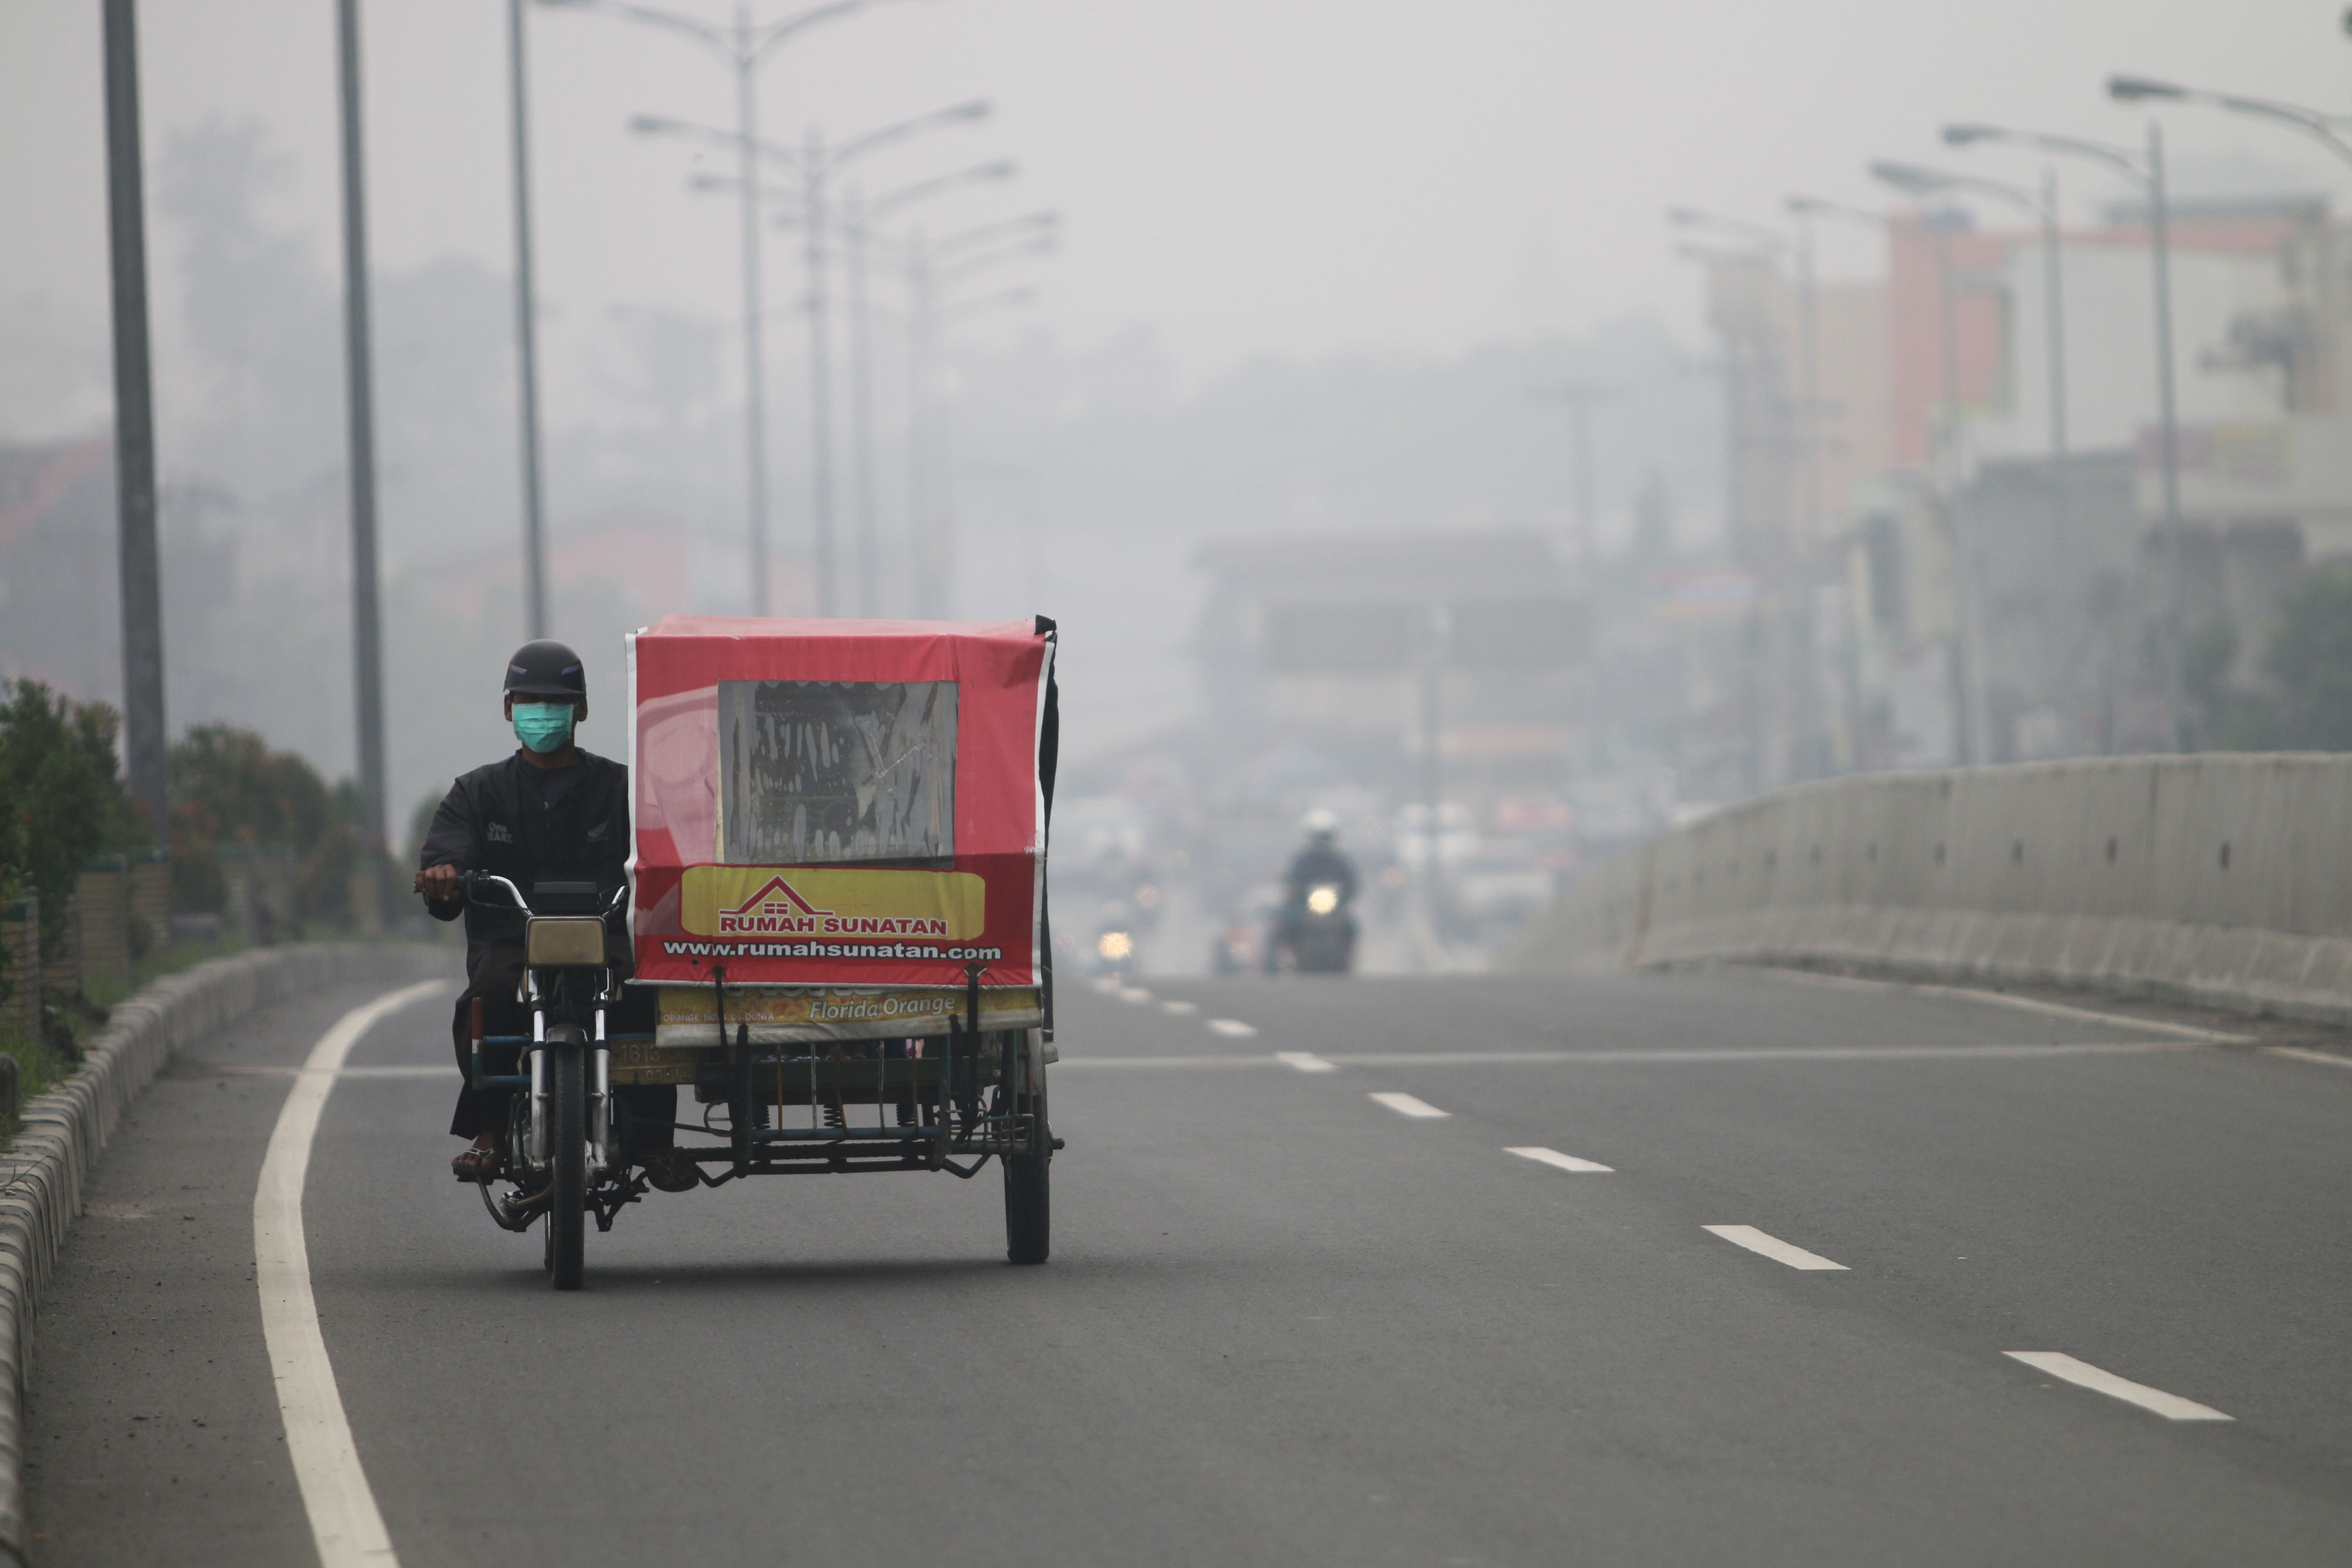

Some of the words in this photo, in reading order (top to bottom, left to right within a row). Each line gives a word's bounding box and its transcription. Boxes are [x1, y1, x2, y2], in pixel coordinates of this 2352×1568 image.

[720, 916, 816, 933] RUMAH
[823, 917, 947, 936] SUNATAN
[663, 941, 1001, 960] www.rumahsunatan.com
[663, 1013, 700, 1022] ORANGE
[809, 999, 878, 1019] Florida
[882, 997, 956, 1016] Orange
